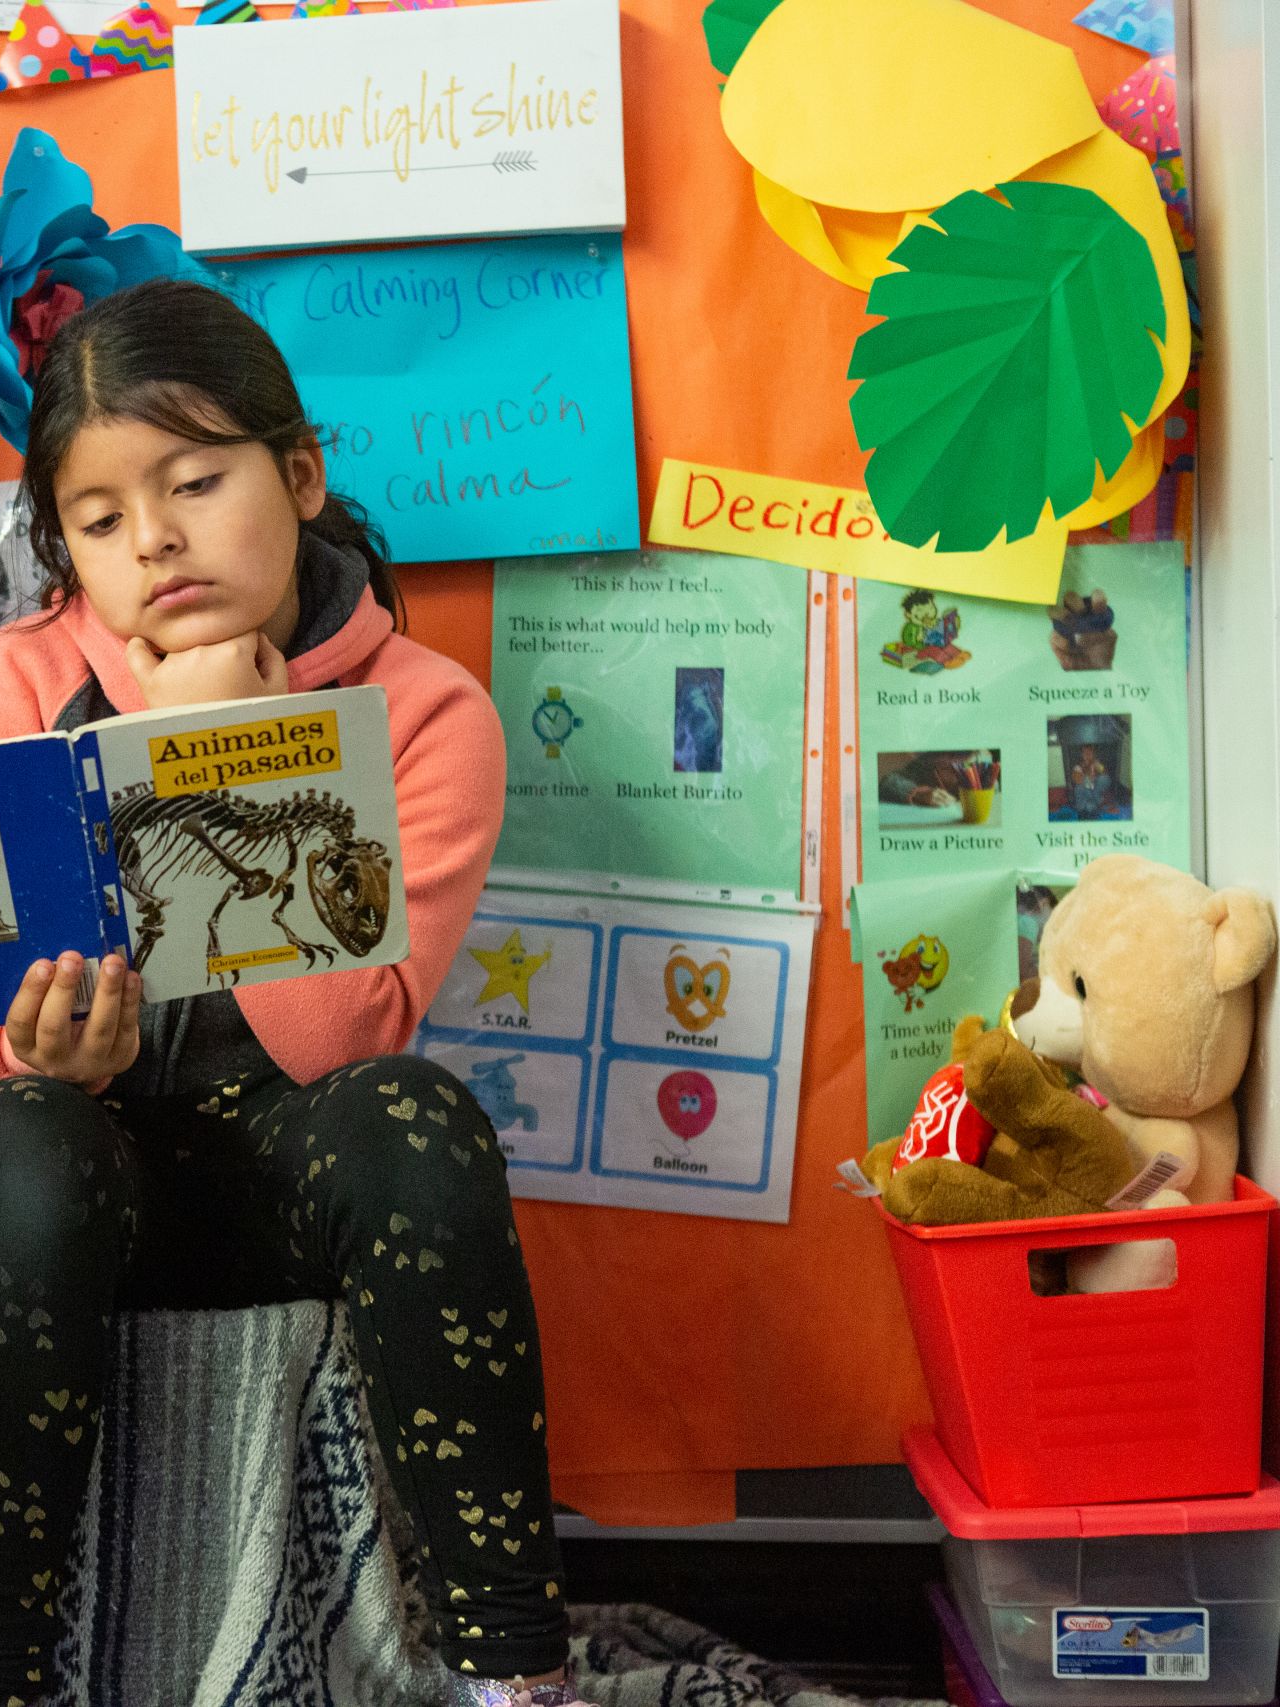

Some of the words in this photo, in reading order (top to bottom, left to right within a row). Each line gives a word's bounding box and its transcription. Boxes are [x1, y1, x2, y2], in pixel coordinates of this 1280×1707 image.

[191, 91, 241, 168] let
[251, 104, 352, 194] your
[362, 70, 464, 182] light
[471, 63, 598, 137] shine
[303, 263, 461, 340] Calming
[477, 254, 609, 309] Corner
[412, 373, 585, 455] rincón
[387, 459, 572, 511] calma
[572, 577, 608, 593] This
[612, 578, 625, 593] is
[628, 577, 664, 593] how
[669, 578, 675, 593] I
[679, 577, 723, 594] feel...
[508, 616, 544, 632] This
[549, 618, 562, 632] is
[566, 617, 605, 633] what
[611, 618, 660, 634] would
[665, 618, 700, 637] help
[705, 623, 731, 638] my
[734, 618, 775, 638] body
[508, 637, 539, 654] feel
[541, 637, 604, 654] better...
[877, 690, 918, 706] Read
[924, 694, 933, 705] a
[939, 687, 981, 704] Book
[1029, 684, 1098, 704] Squeeze
[1103, 689, 1113, 700] a
[1117, 684, 1150, 703] Toy
[155, 721, 324, 765] Animales
[174, 766, 208, 787] del
[216, 744, 335, 786] pasado
[506, 784, 548, 797] some
[552, 782, 589, 797] time
[616, 783, 677, 800] Blanket
[683, 784, 742, 801] Burrito
[880, 836, 925, 852] Draw
[929, 840, 938, 851] a
[944, 834, 1003, 851] Picture
[1035, 832, 1074, 848] Visit
[1080, 832, 1108, 847] the
[1112, 831, 1149, 847] Safe
[482, 1012, 532, 1029] S.T.A.R.
[881, 1022, 921, 1041] Time
[924, 1018, 956, 1036] with
[665, 1031, 718, 1049] Pretzel
[890, 1049, 898, 1060] a
[903, 1041, 944, 1061] teddy
[652, 1155, 708, 1175] Balloon
